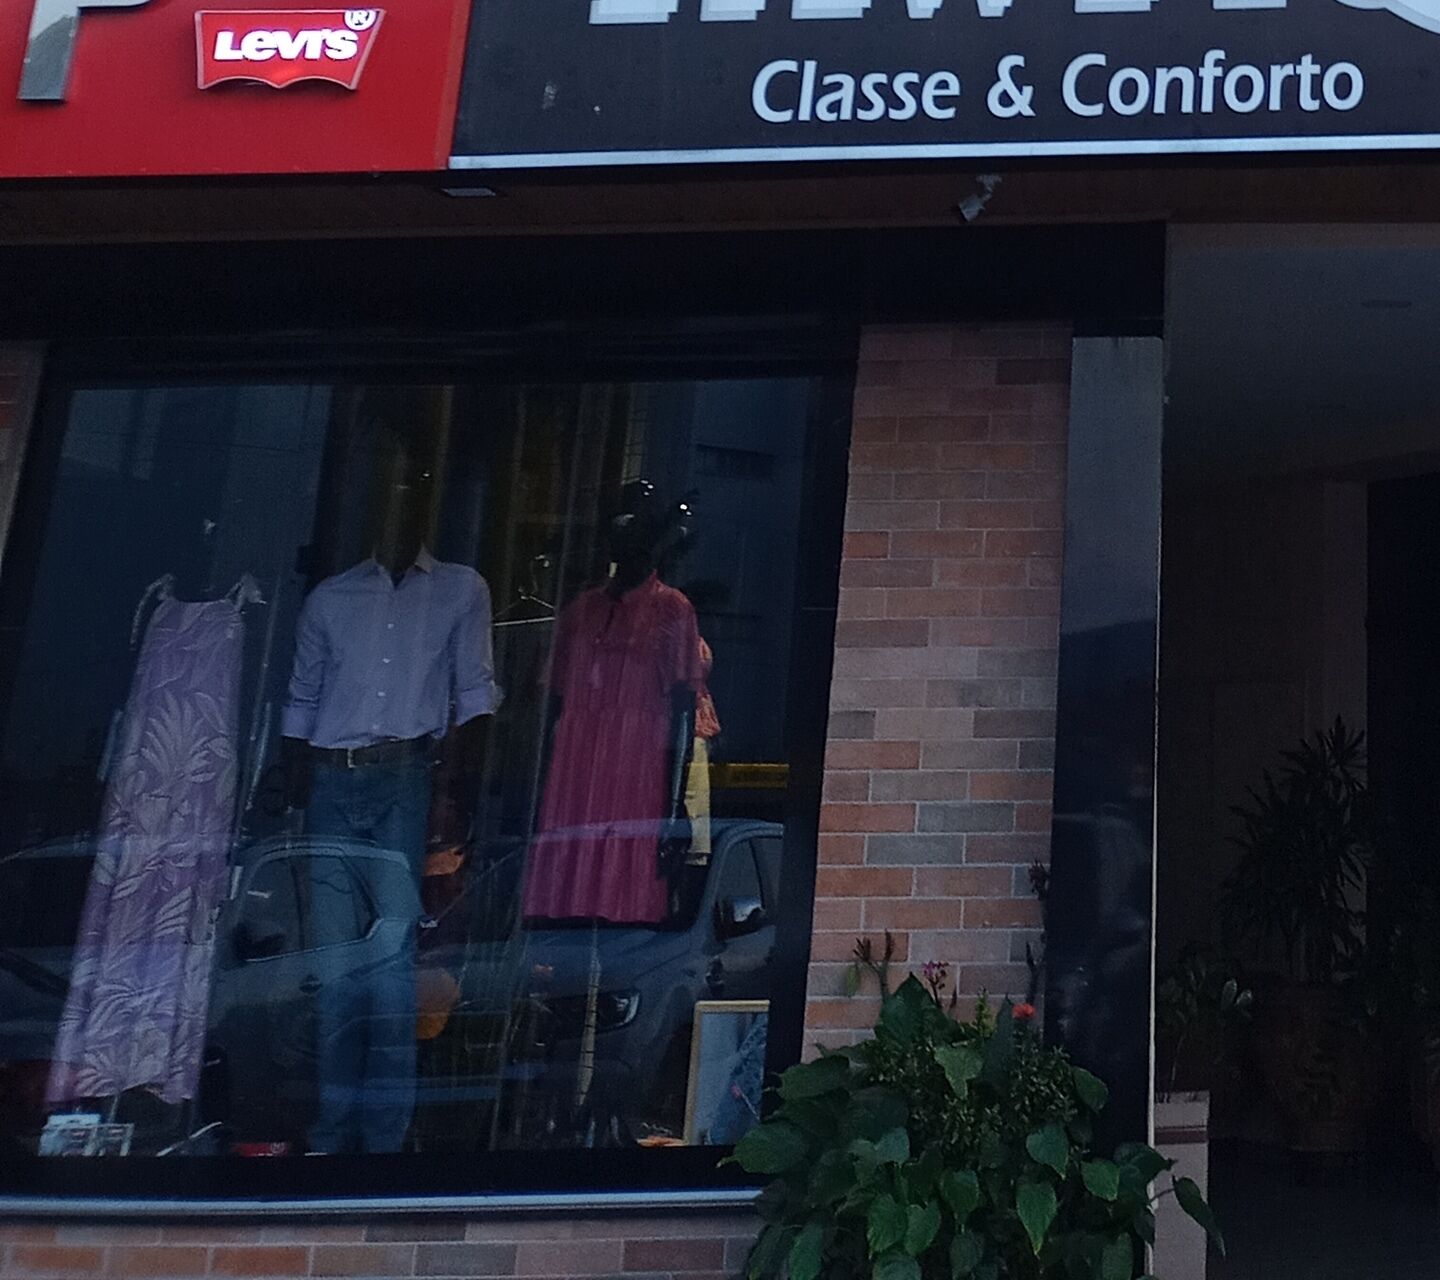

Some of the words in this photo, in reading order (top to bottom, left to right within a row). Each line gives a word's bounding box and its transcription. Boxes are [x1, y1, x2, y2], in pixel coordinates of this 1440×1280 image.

[750, 58, 961, 124] Classe
[986, 54, 1036, 117] &
[1061, 48, 1365, 115] Conforto
